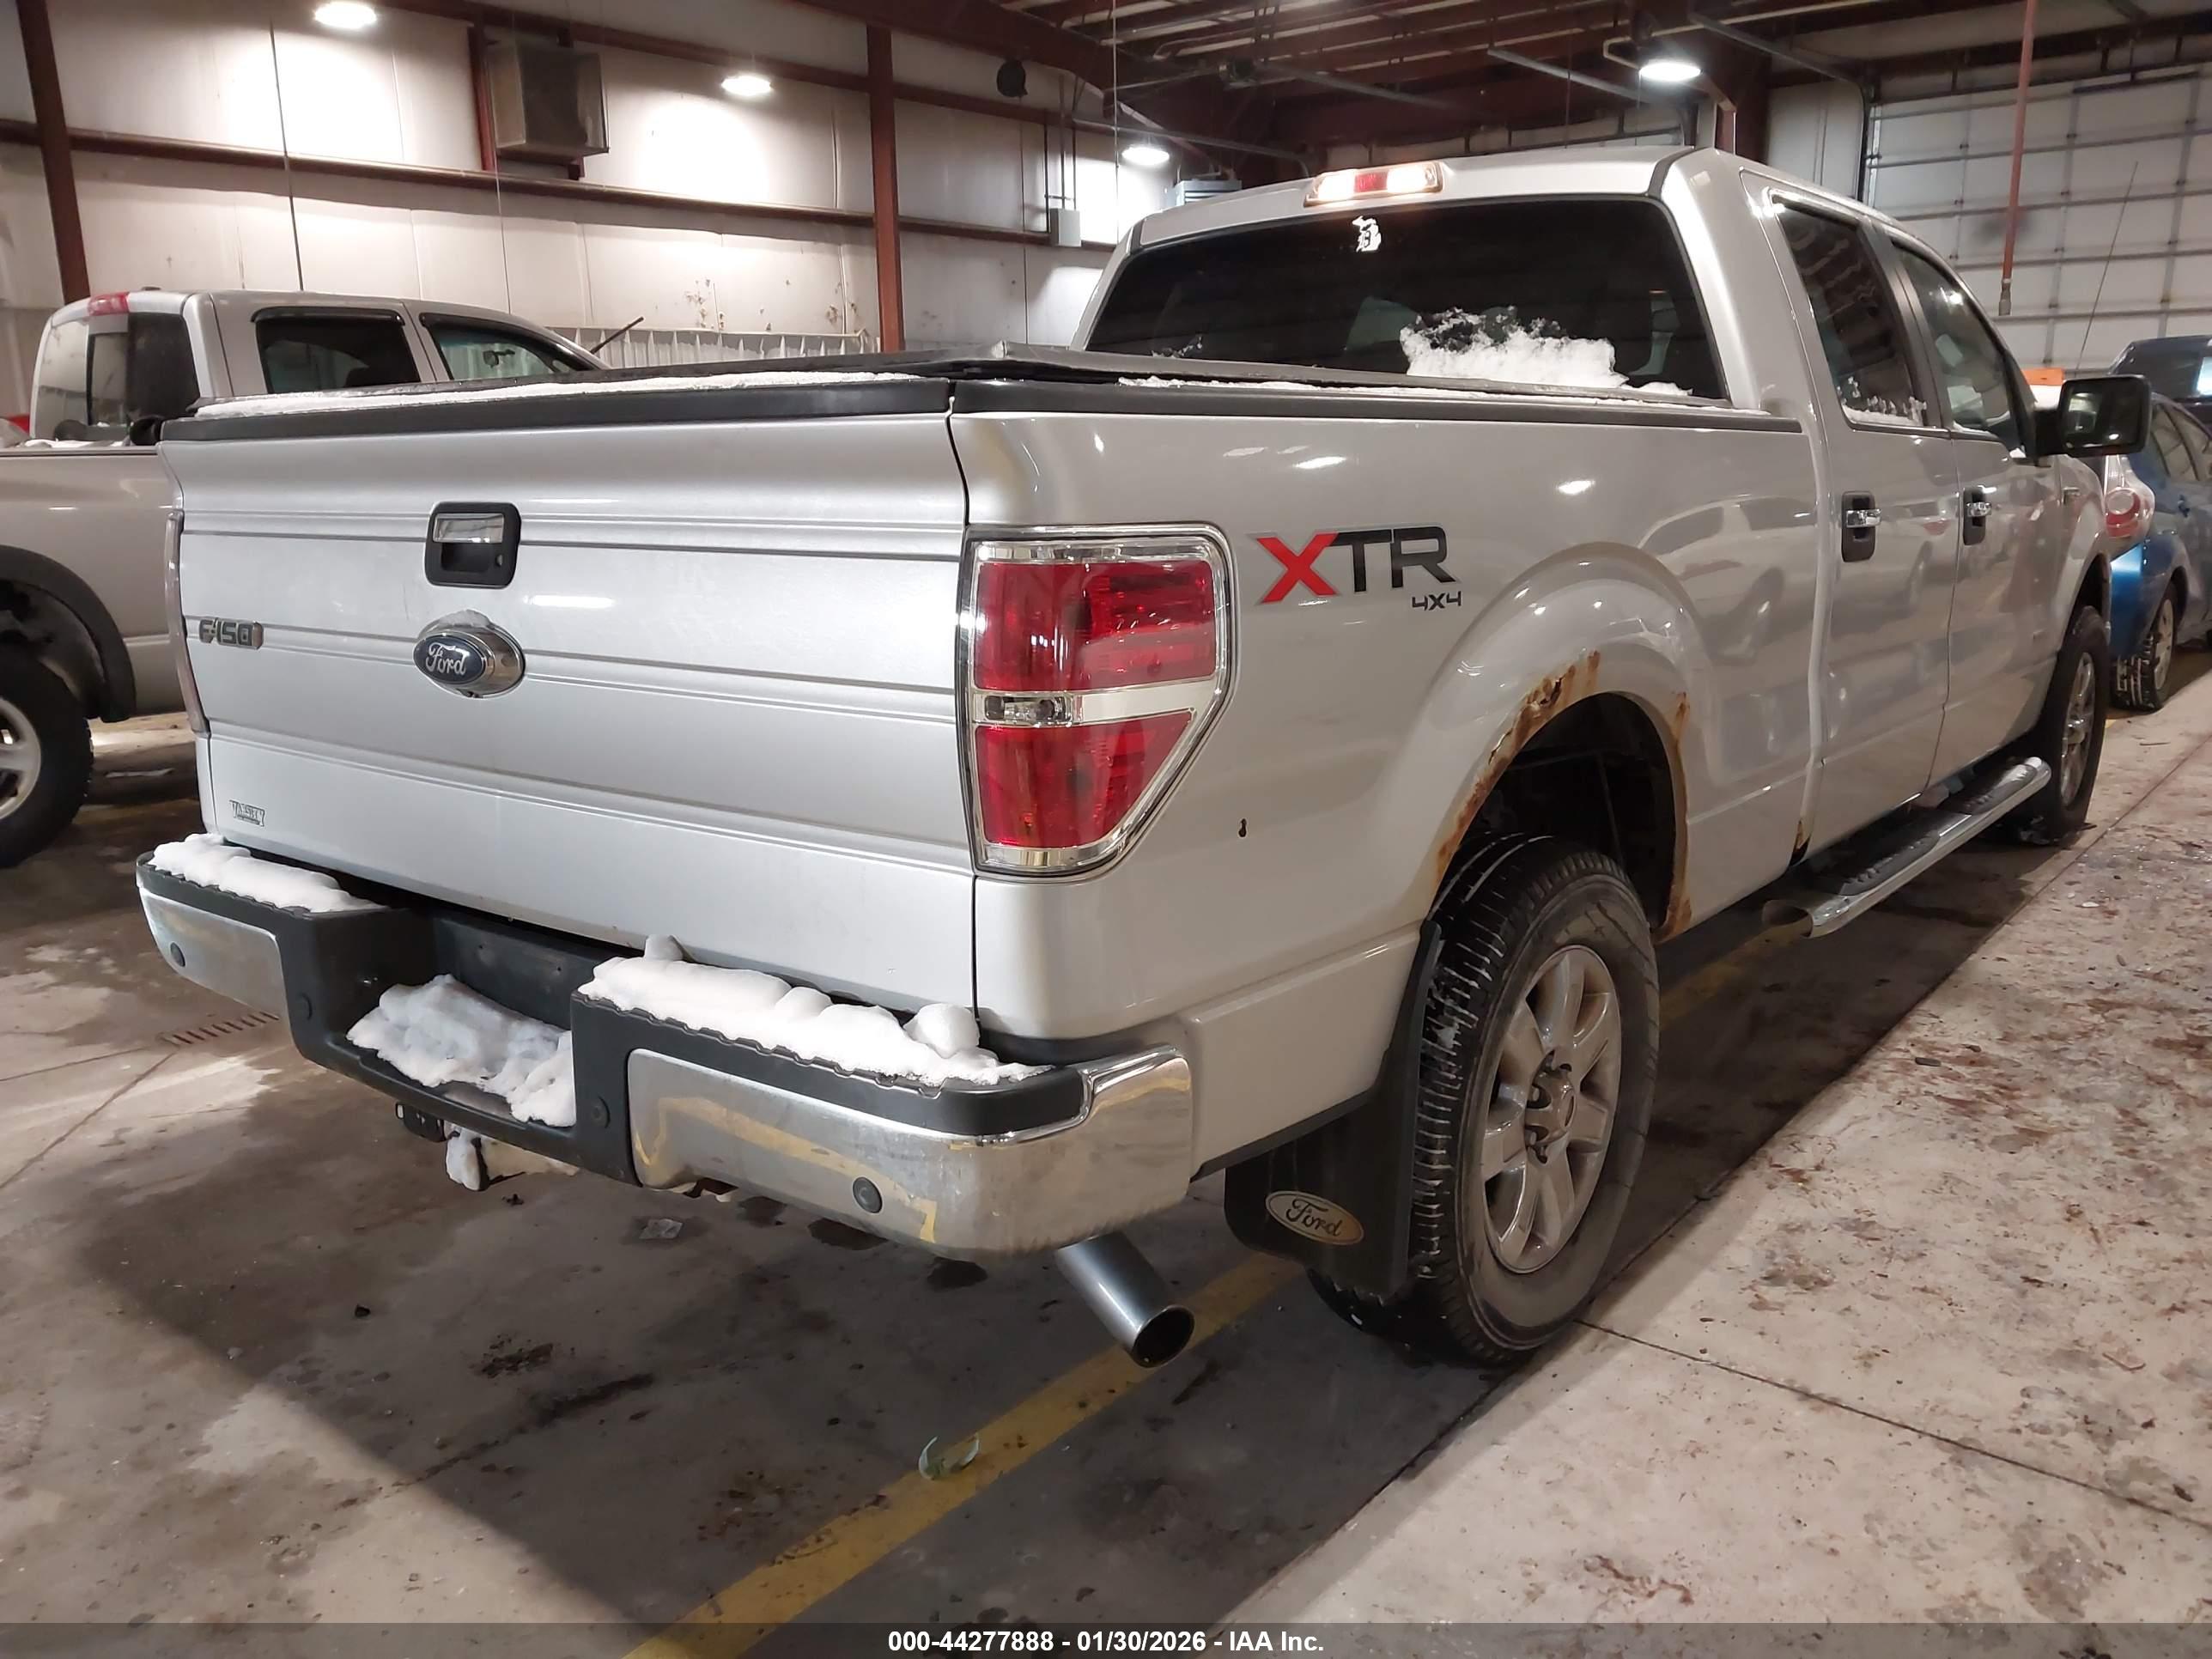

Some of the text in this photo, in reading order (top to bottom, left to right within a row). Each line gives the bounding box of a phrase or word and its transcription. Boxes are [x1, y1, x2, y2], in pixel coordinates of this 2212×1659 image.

[1256, 526, 1457, 604] XTR
[425, 641, 471, 675] Ford
[1285, 1198, 1343, 1237] Ford
